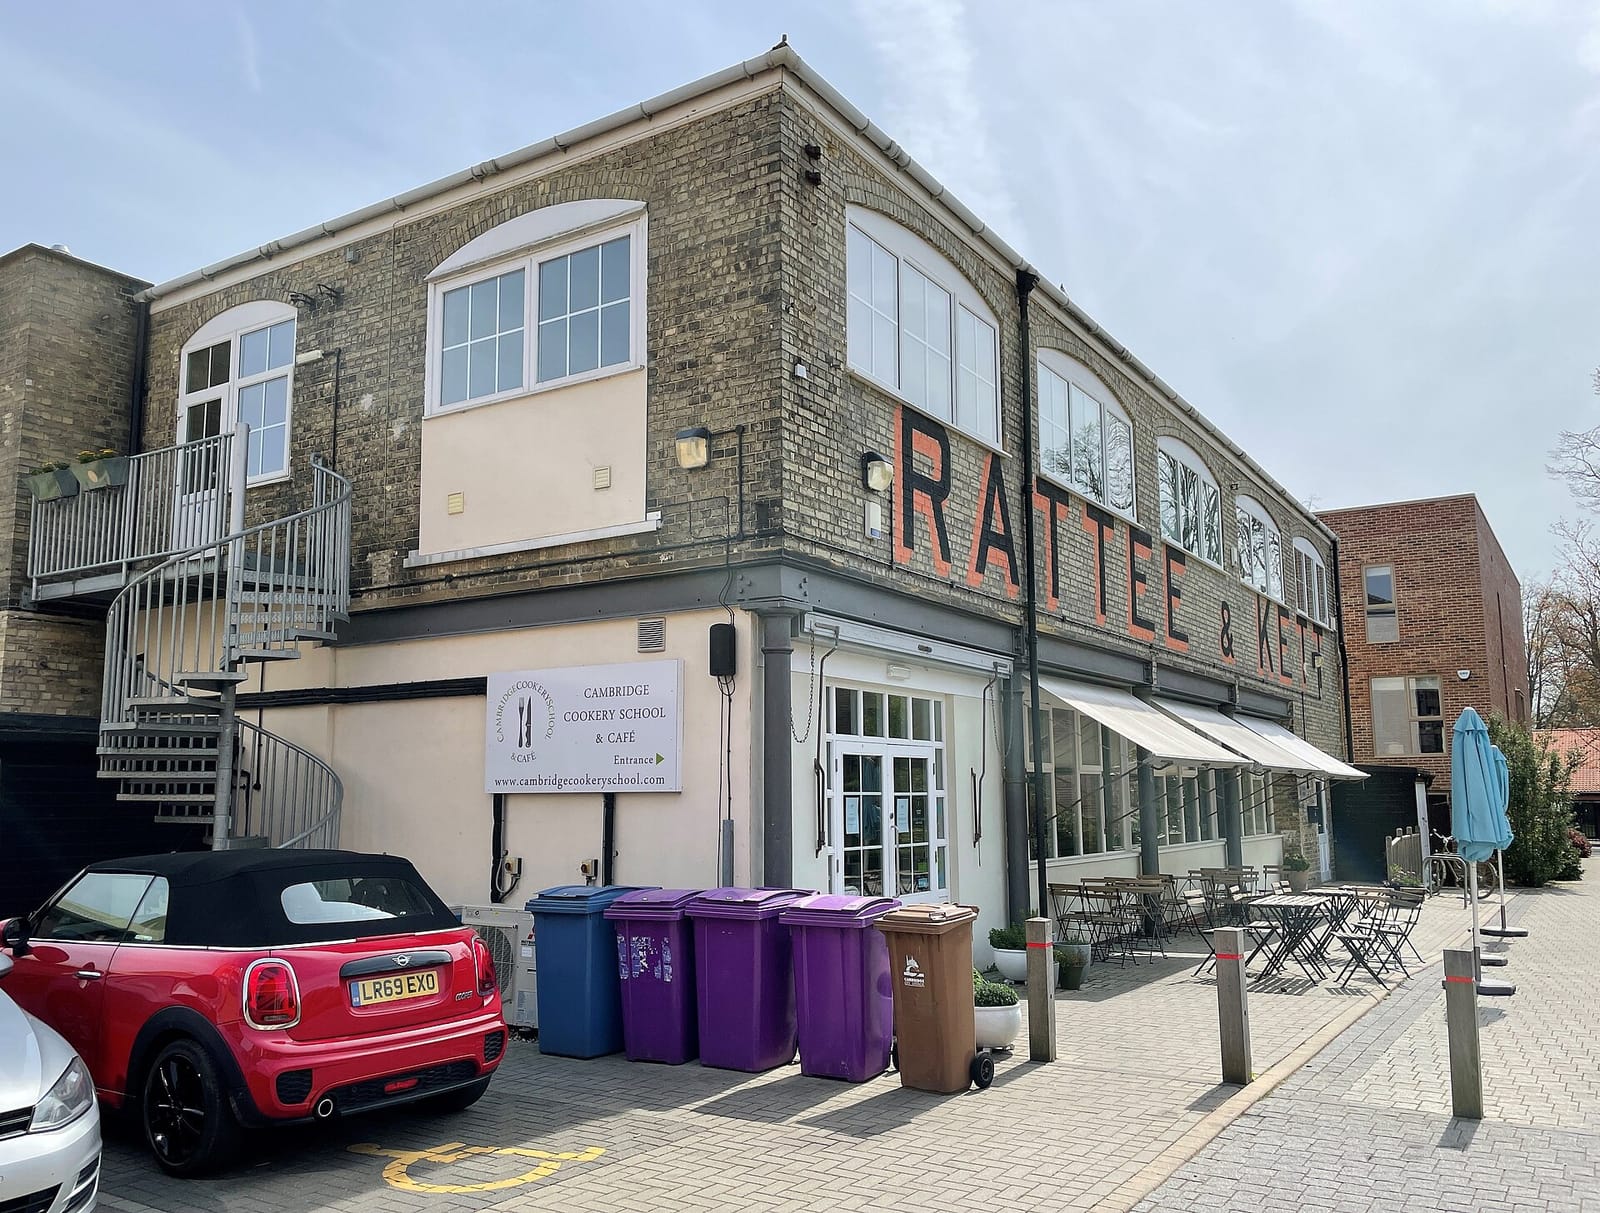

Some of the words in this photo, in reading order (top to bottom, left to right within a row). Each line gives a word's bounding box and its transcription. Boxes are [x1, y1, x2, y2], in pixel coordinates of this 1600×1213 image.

[894, 404, 1189, 653] RATTEE
[1219, 600, 1236, 664] &
[1255, 594, 1323, 690] KETT
[584, 684, 650, 699] CAMBRIDGE
[563, 709, 615, 722] COOKERY
[619, 707, 666, 720] SCHOOL
[595, 733, 603, 744] &
[607, 730, 636, 744] CAFÉ
[614, 755, 654, 765] Entrance
[494, 773, 665, 789] www.cambridgecookeryschool.com
[362, 978, 404, 1000] LR69
